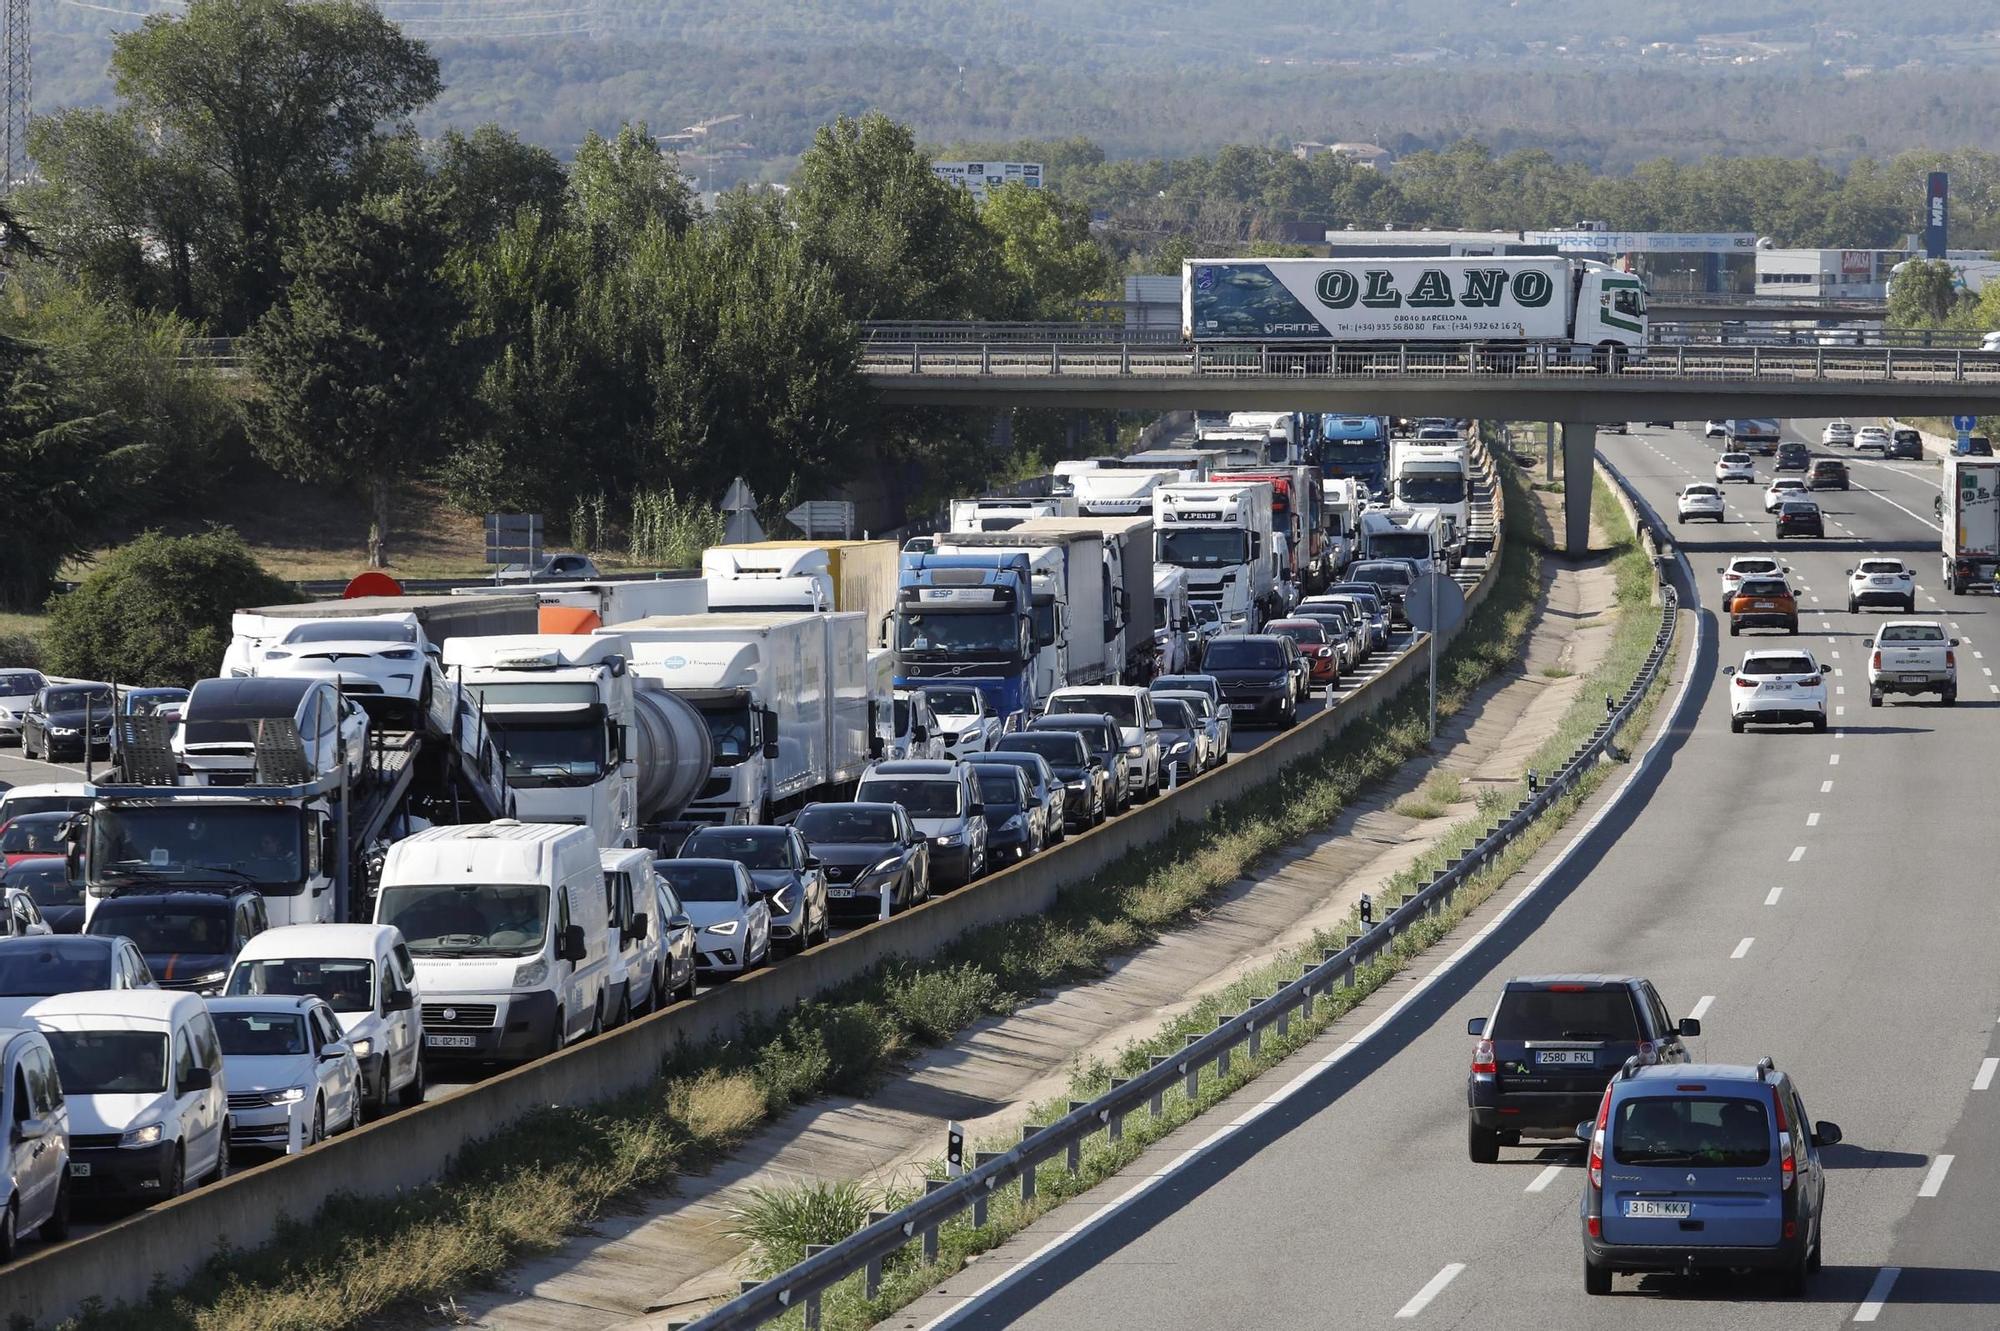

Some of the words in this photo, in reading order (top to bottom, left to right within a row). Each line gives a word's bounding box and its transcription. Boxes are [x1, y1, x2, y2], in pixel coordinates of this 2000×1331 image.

[1536, 236, 1621, 247] TORROT
[1315, 269, 1553, 309] OLANO
[1354, 323, 1375, 333] (+34)
[1393, 323, 1402, 331] 56
[1404, 323, 1413, 331] 80
[1415, 323, 1425, 331] 80
[1452, 322, 1472, 332] (+34)
[1542, 1053, 1567, 1062] 2580
[1574, 1053, 1593, 1062] FKL
[1631, 1203, 1660, 1214] 3161
[1665, 1203, 1688, 1214] KKX
